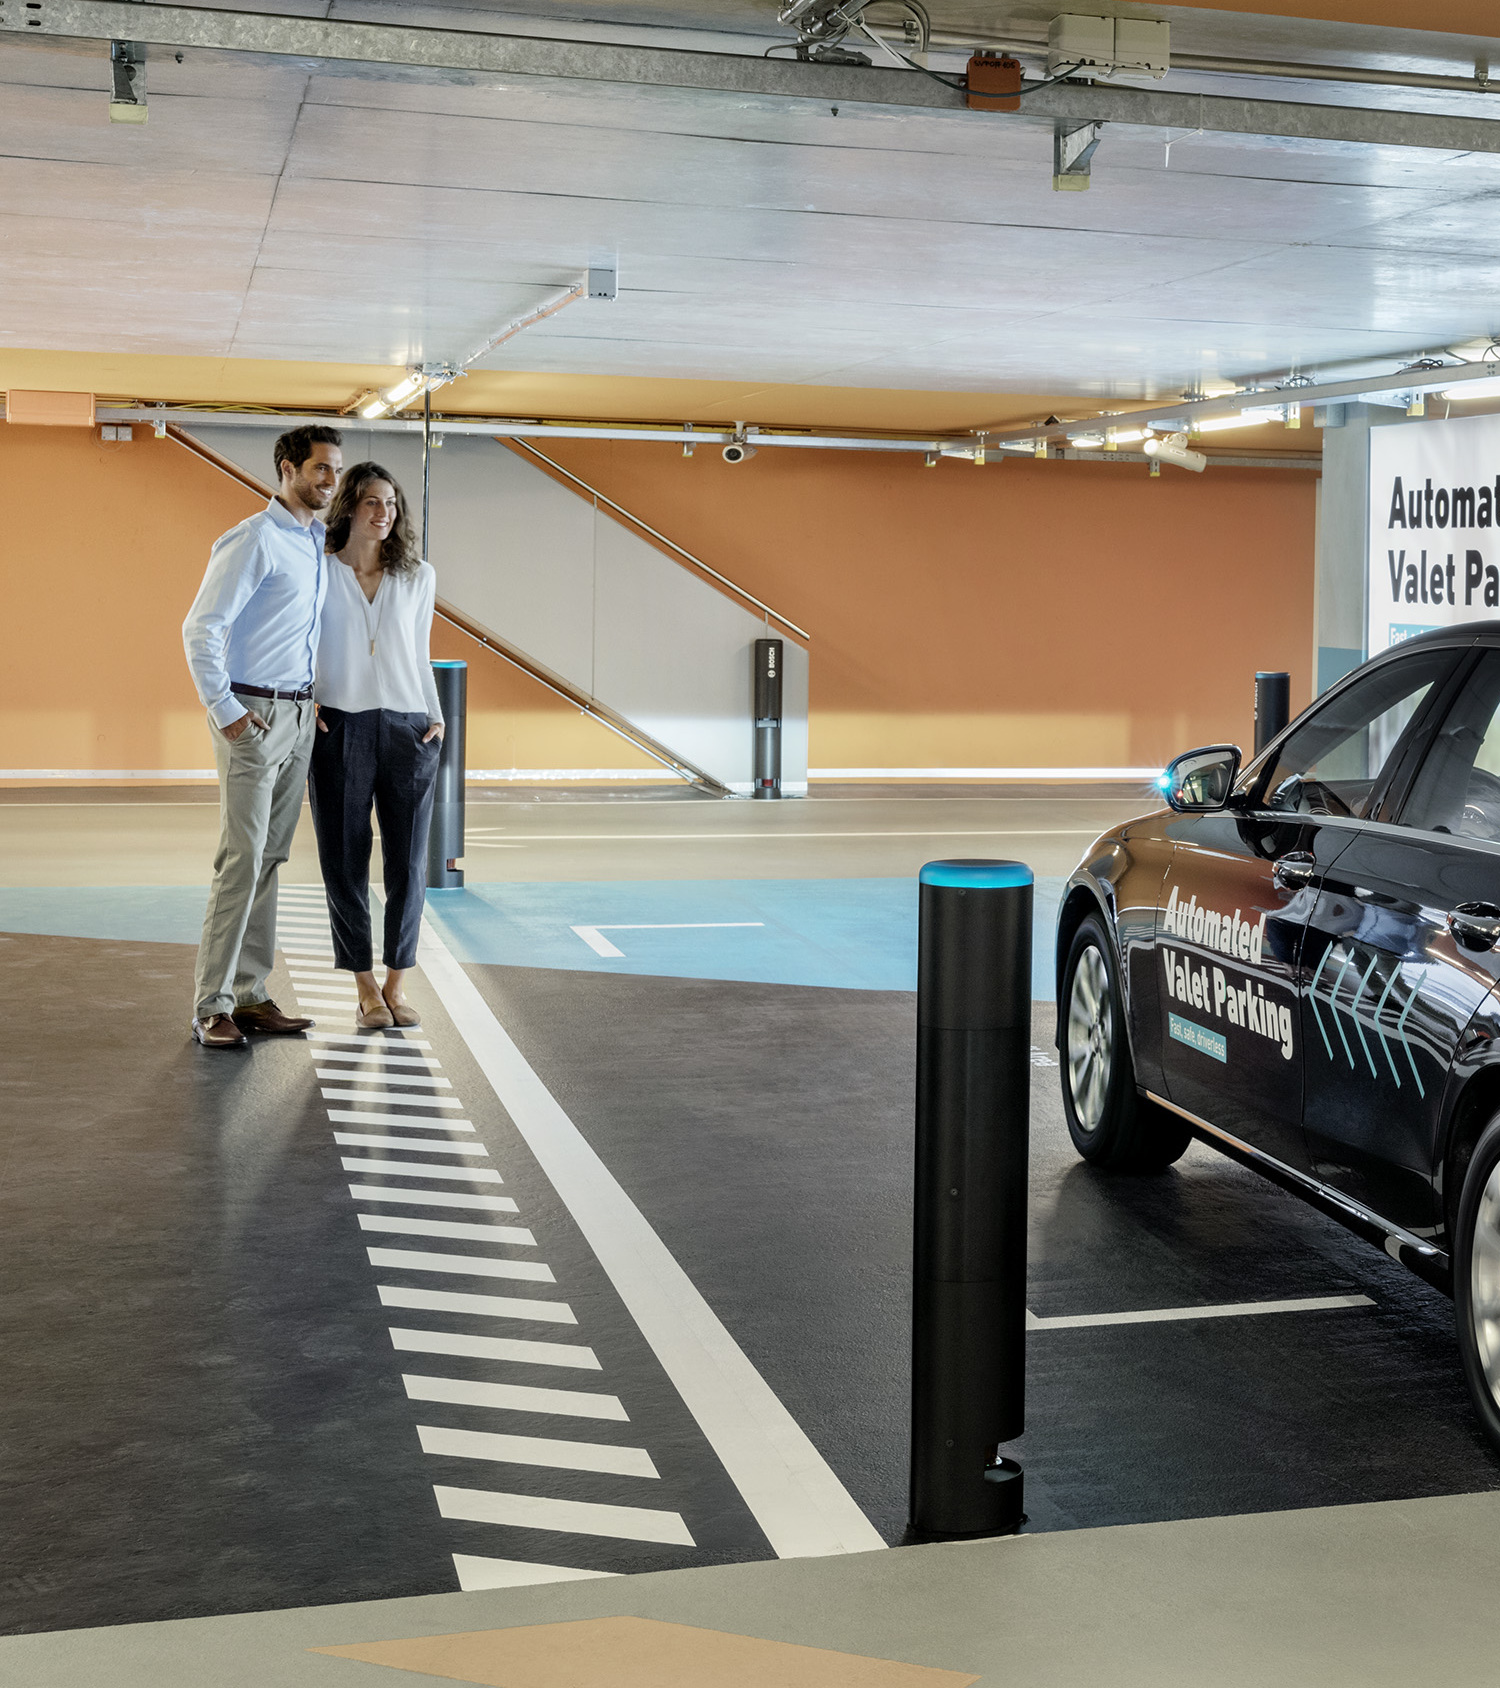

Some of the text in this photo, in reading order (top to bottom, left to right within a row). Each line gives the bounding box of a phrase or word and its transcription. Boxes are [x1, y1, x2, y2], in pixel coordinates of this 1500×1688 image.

[1388, 549, 1456, 606] Valet
[1163, 885, 1267, 965] Automated
[1162, 947, 1293, 1060] Valet Parking
[1170, 1017, 1225, 1057] Fast, safe, driverless
